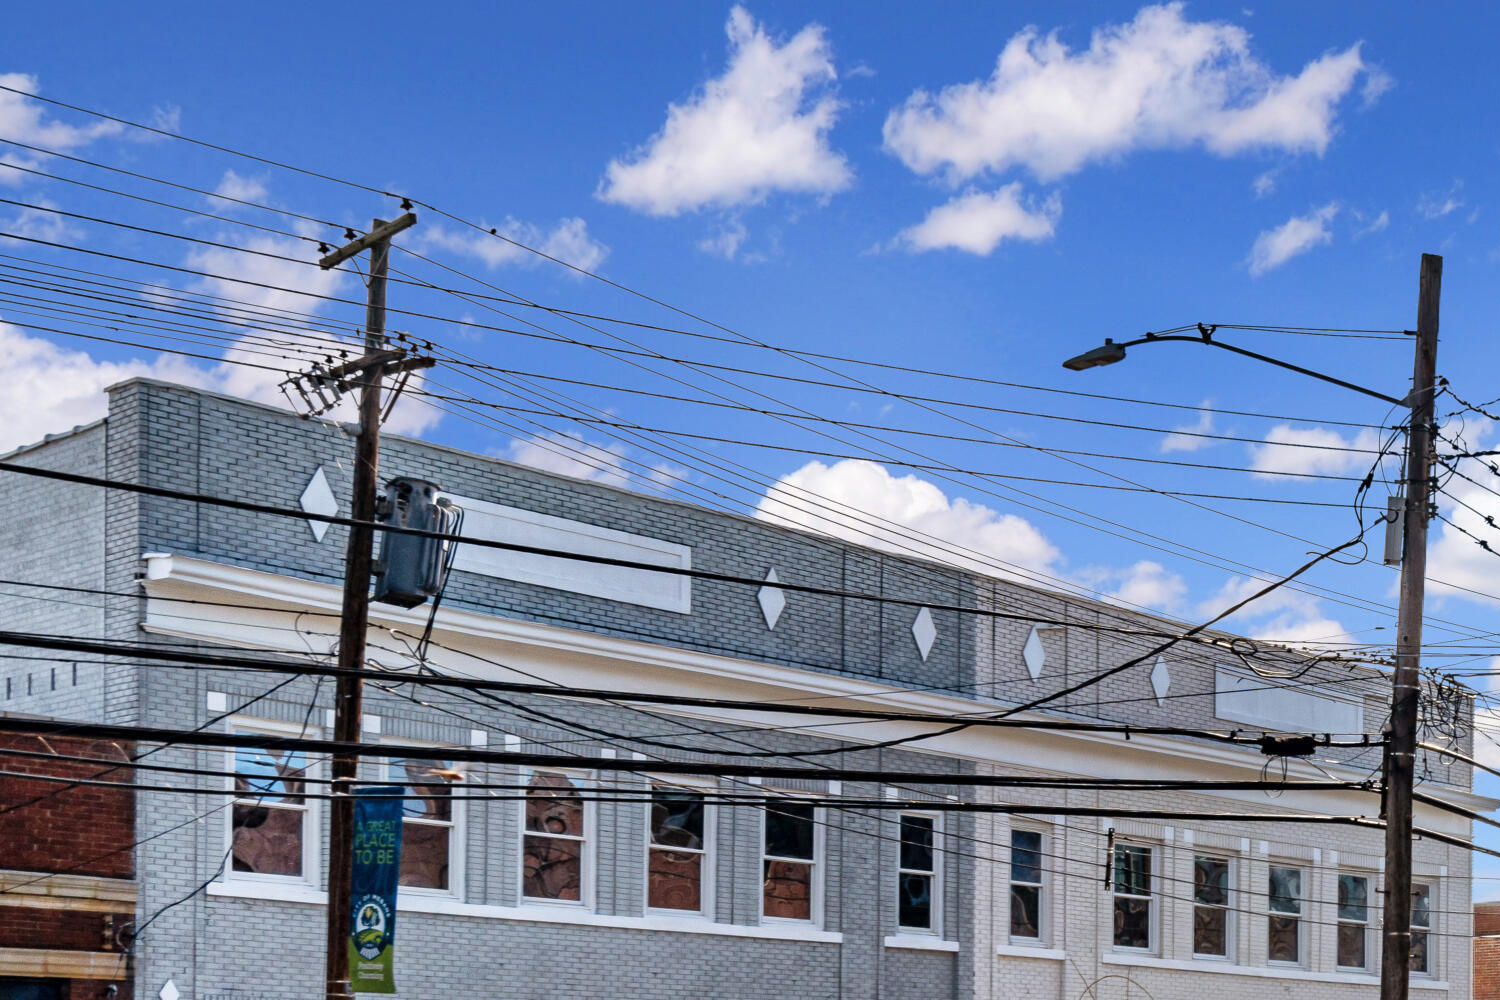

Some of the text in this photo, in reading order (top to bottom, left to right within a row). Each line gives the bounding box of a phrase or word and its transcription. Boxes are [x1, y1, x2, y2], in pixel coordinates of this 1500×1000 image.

[355, 832, 396, 848] PLACE
[355, 849, 394, 865] TO BE
